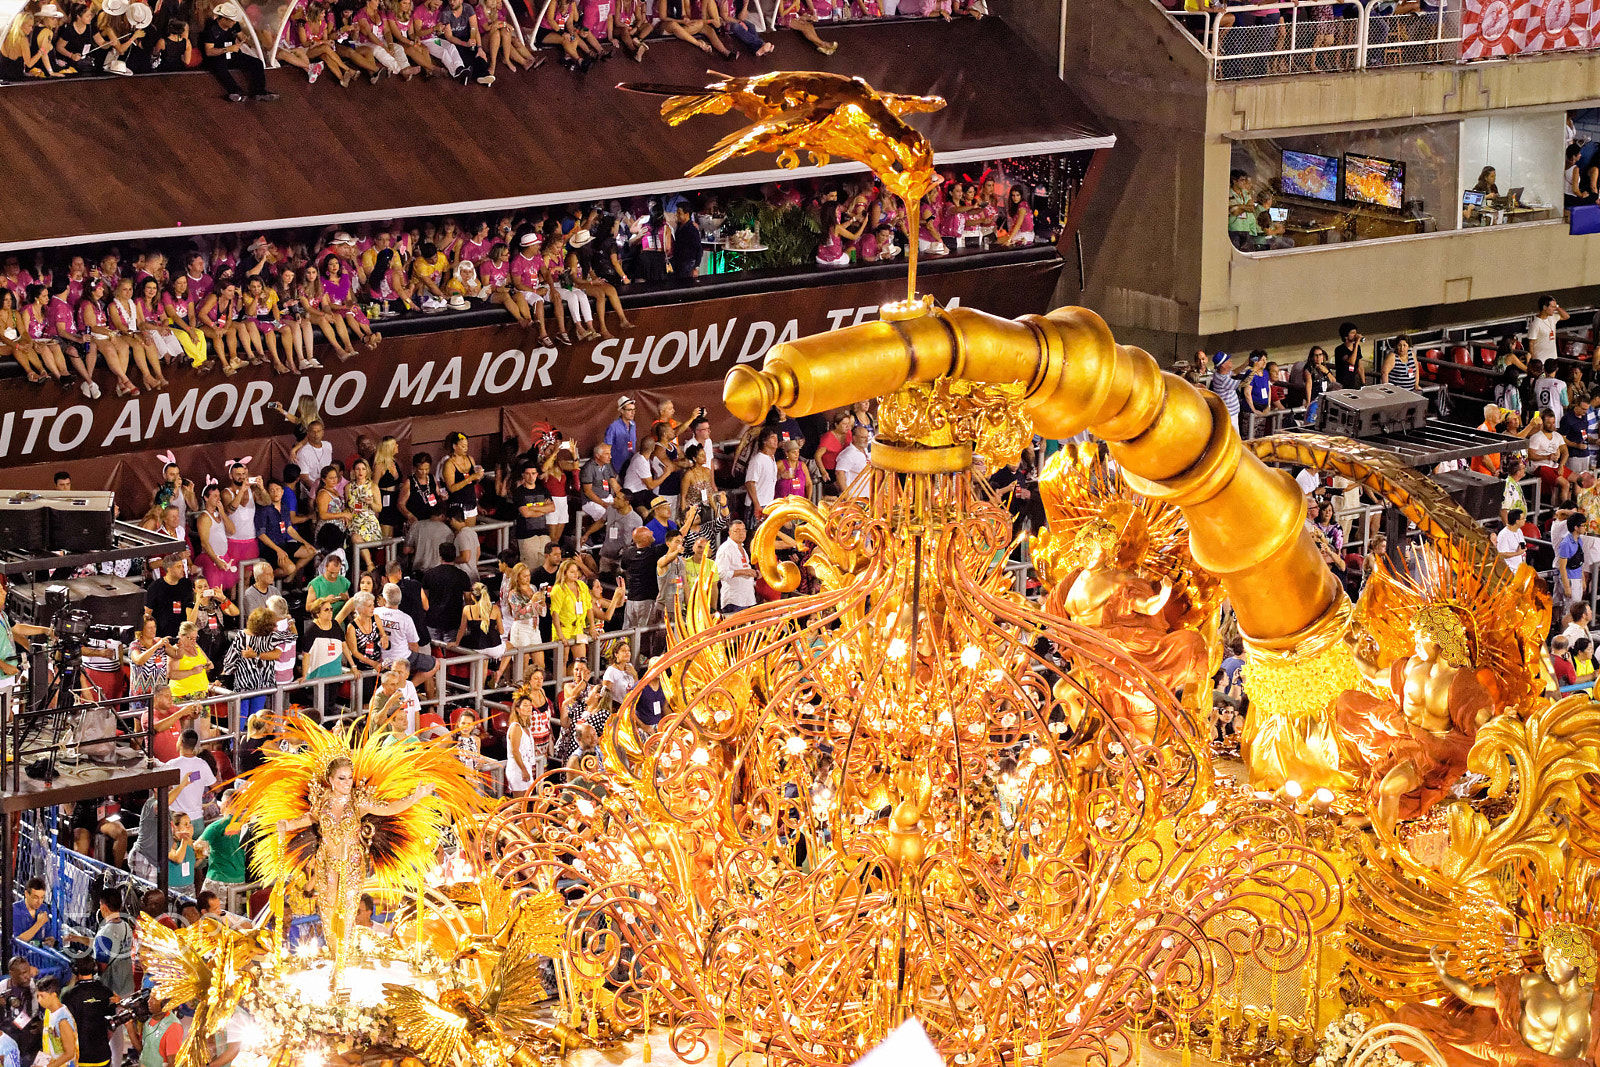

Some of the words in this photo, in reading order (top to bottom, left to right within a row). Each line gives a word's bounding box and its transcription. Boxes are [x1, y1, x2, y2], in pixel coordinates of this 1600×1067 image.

[100, 380, 274, 447] AMOR
[284, 370, 368, 421] NO
[380, 346, 559, 408] MAIOR
[582, 317, 738, 384] SHOW
